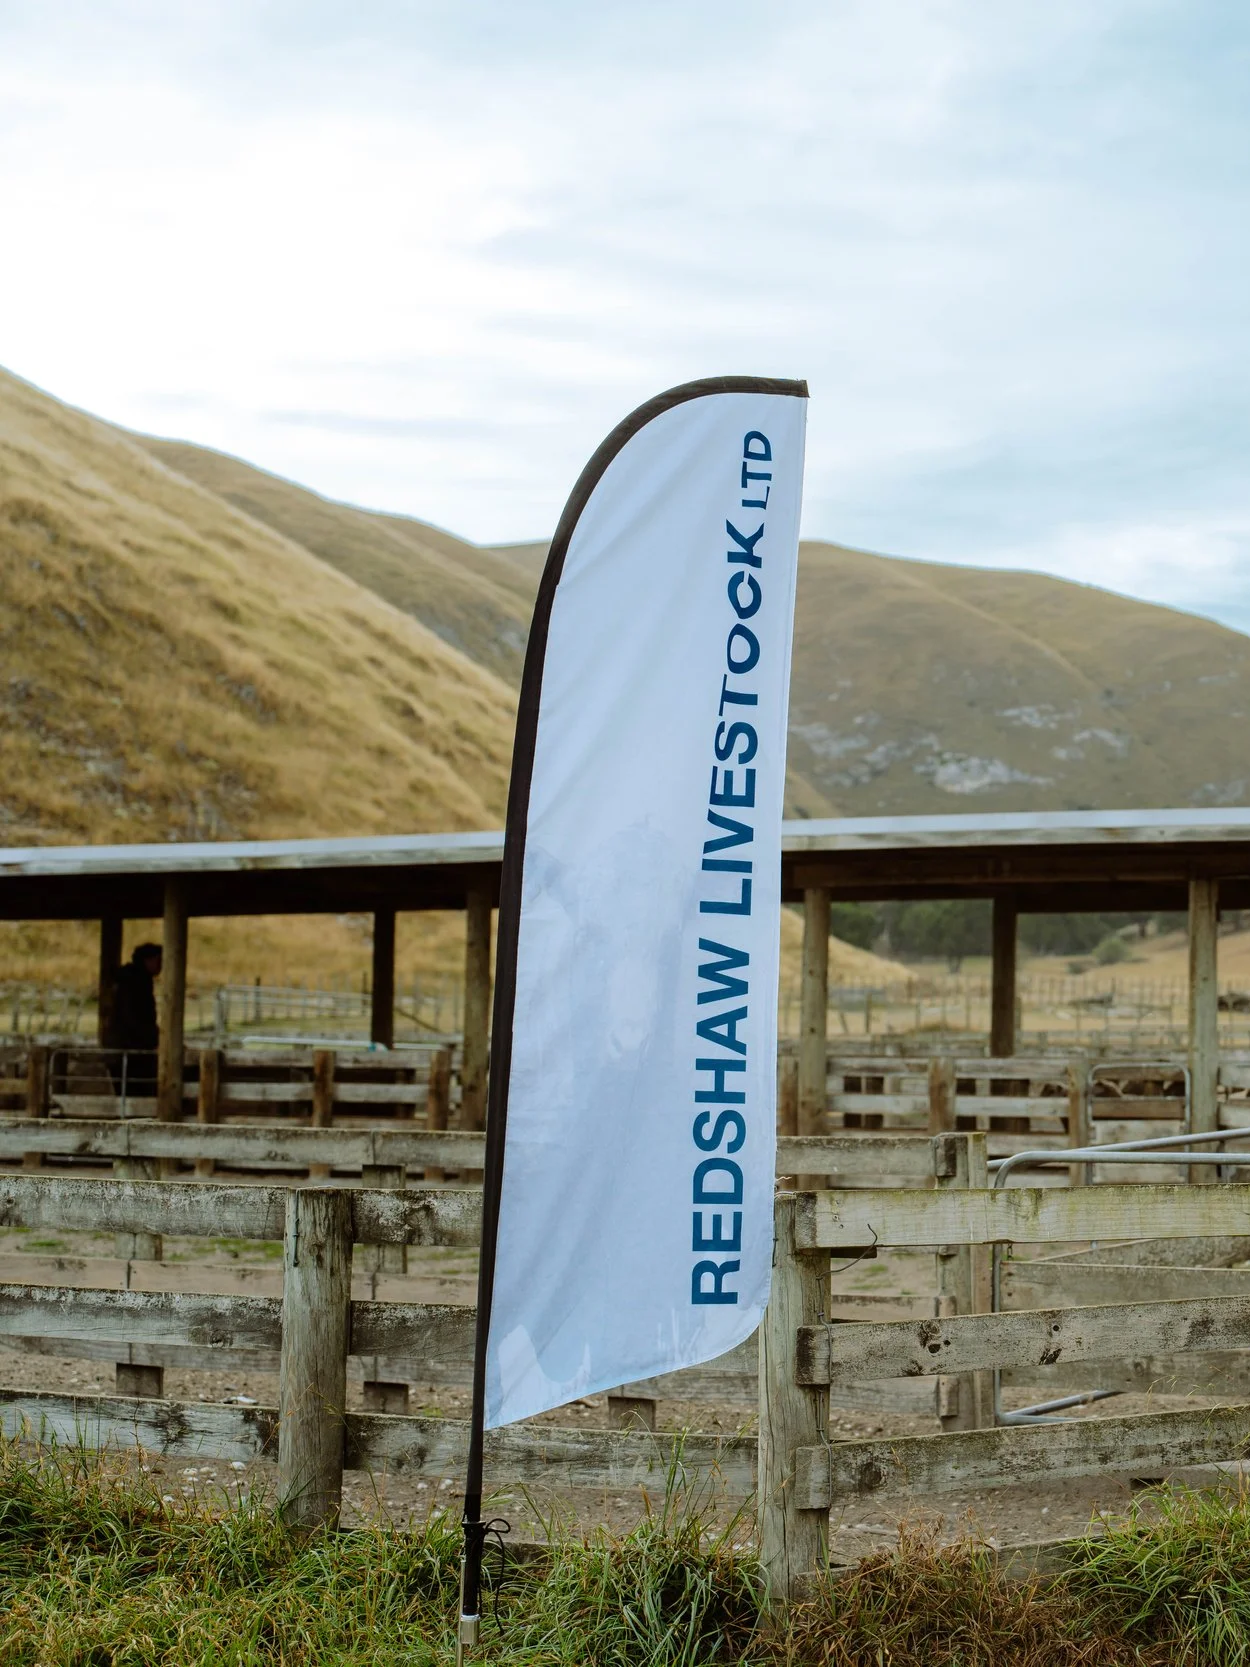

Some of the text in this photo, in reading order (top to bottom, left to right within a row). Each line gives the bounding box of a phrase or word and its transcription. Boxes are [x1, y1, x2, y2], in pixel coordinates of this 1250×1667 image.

[691, 430, 773, 1305] REDSHAW LIVESTOCK LTD
